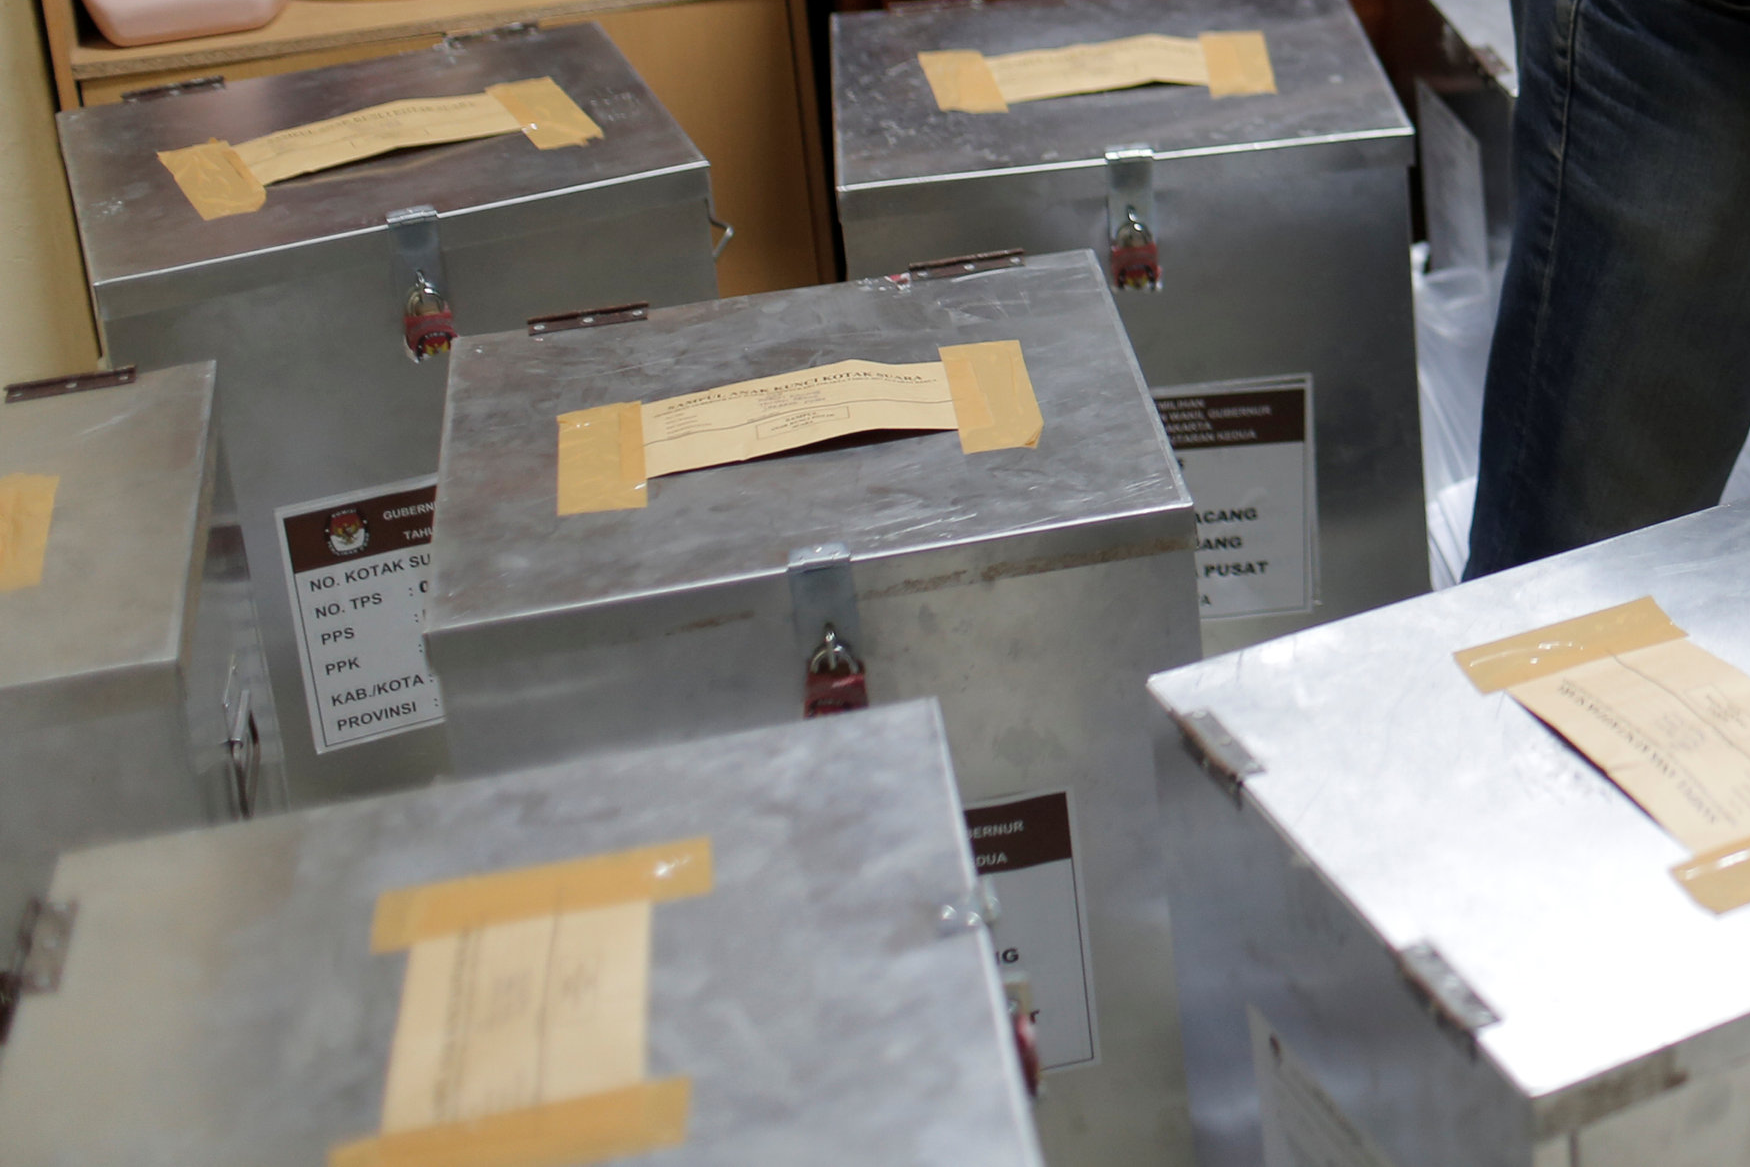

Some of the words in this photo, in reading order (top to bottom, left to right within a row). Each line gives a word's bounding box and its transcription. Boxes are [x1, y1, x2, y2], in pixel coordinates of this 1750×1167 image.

[310, 576, 340, 592] NO.
[345, 559, 404, 583] KOTAK
[1204, 560, 1269, 578] PUSAT
[315, 603, 345, 619] NO.
[350, 593, 382, 610] TPS
[321, 627, 355, 645] PPS
[325, 657, 361, 676] PPK
[331, 674, 424, 707] KAB./KOTA
[337, 701, 417, 731] PROVINSI
